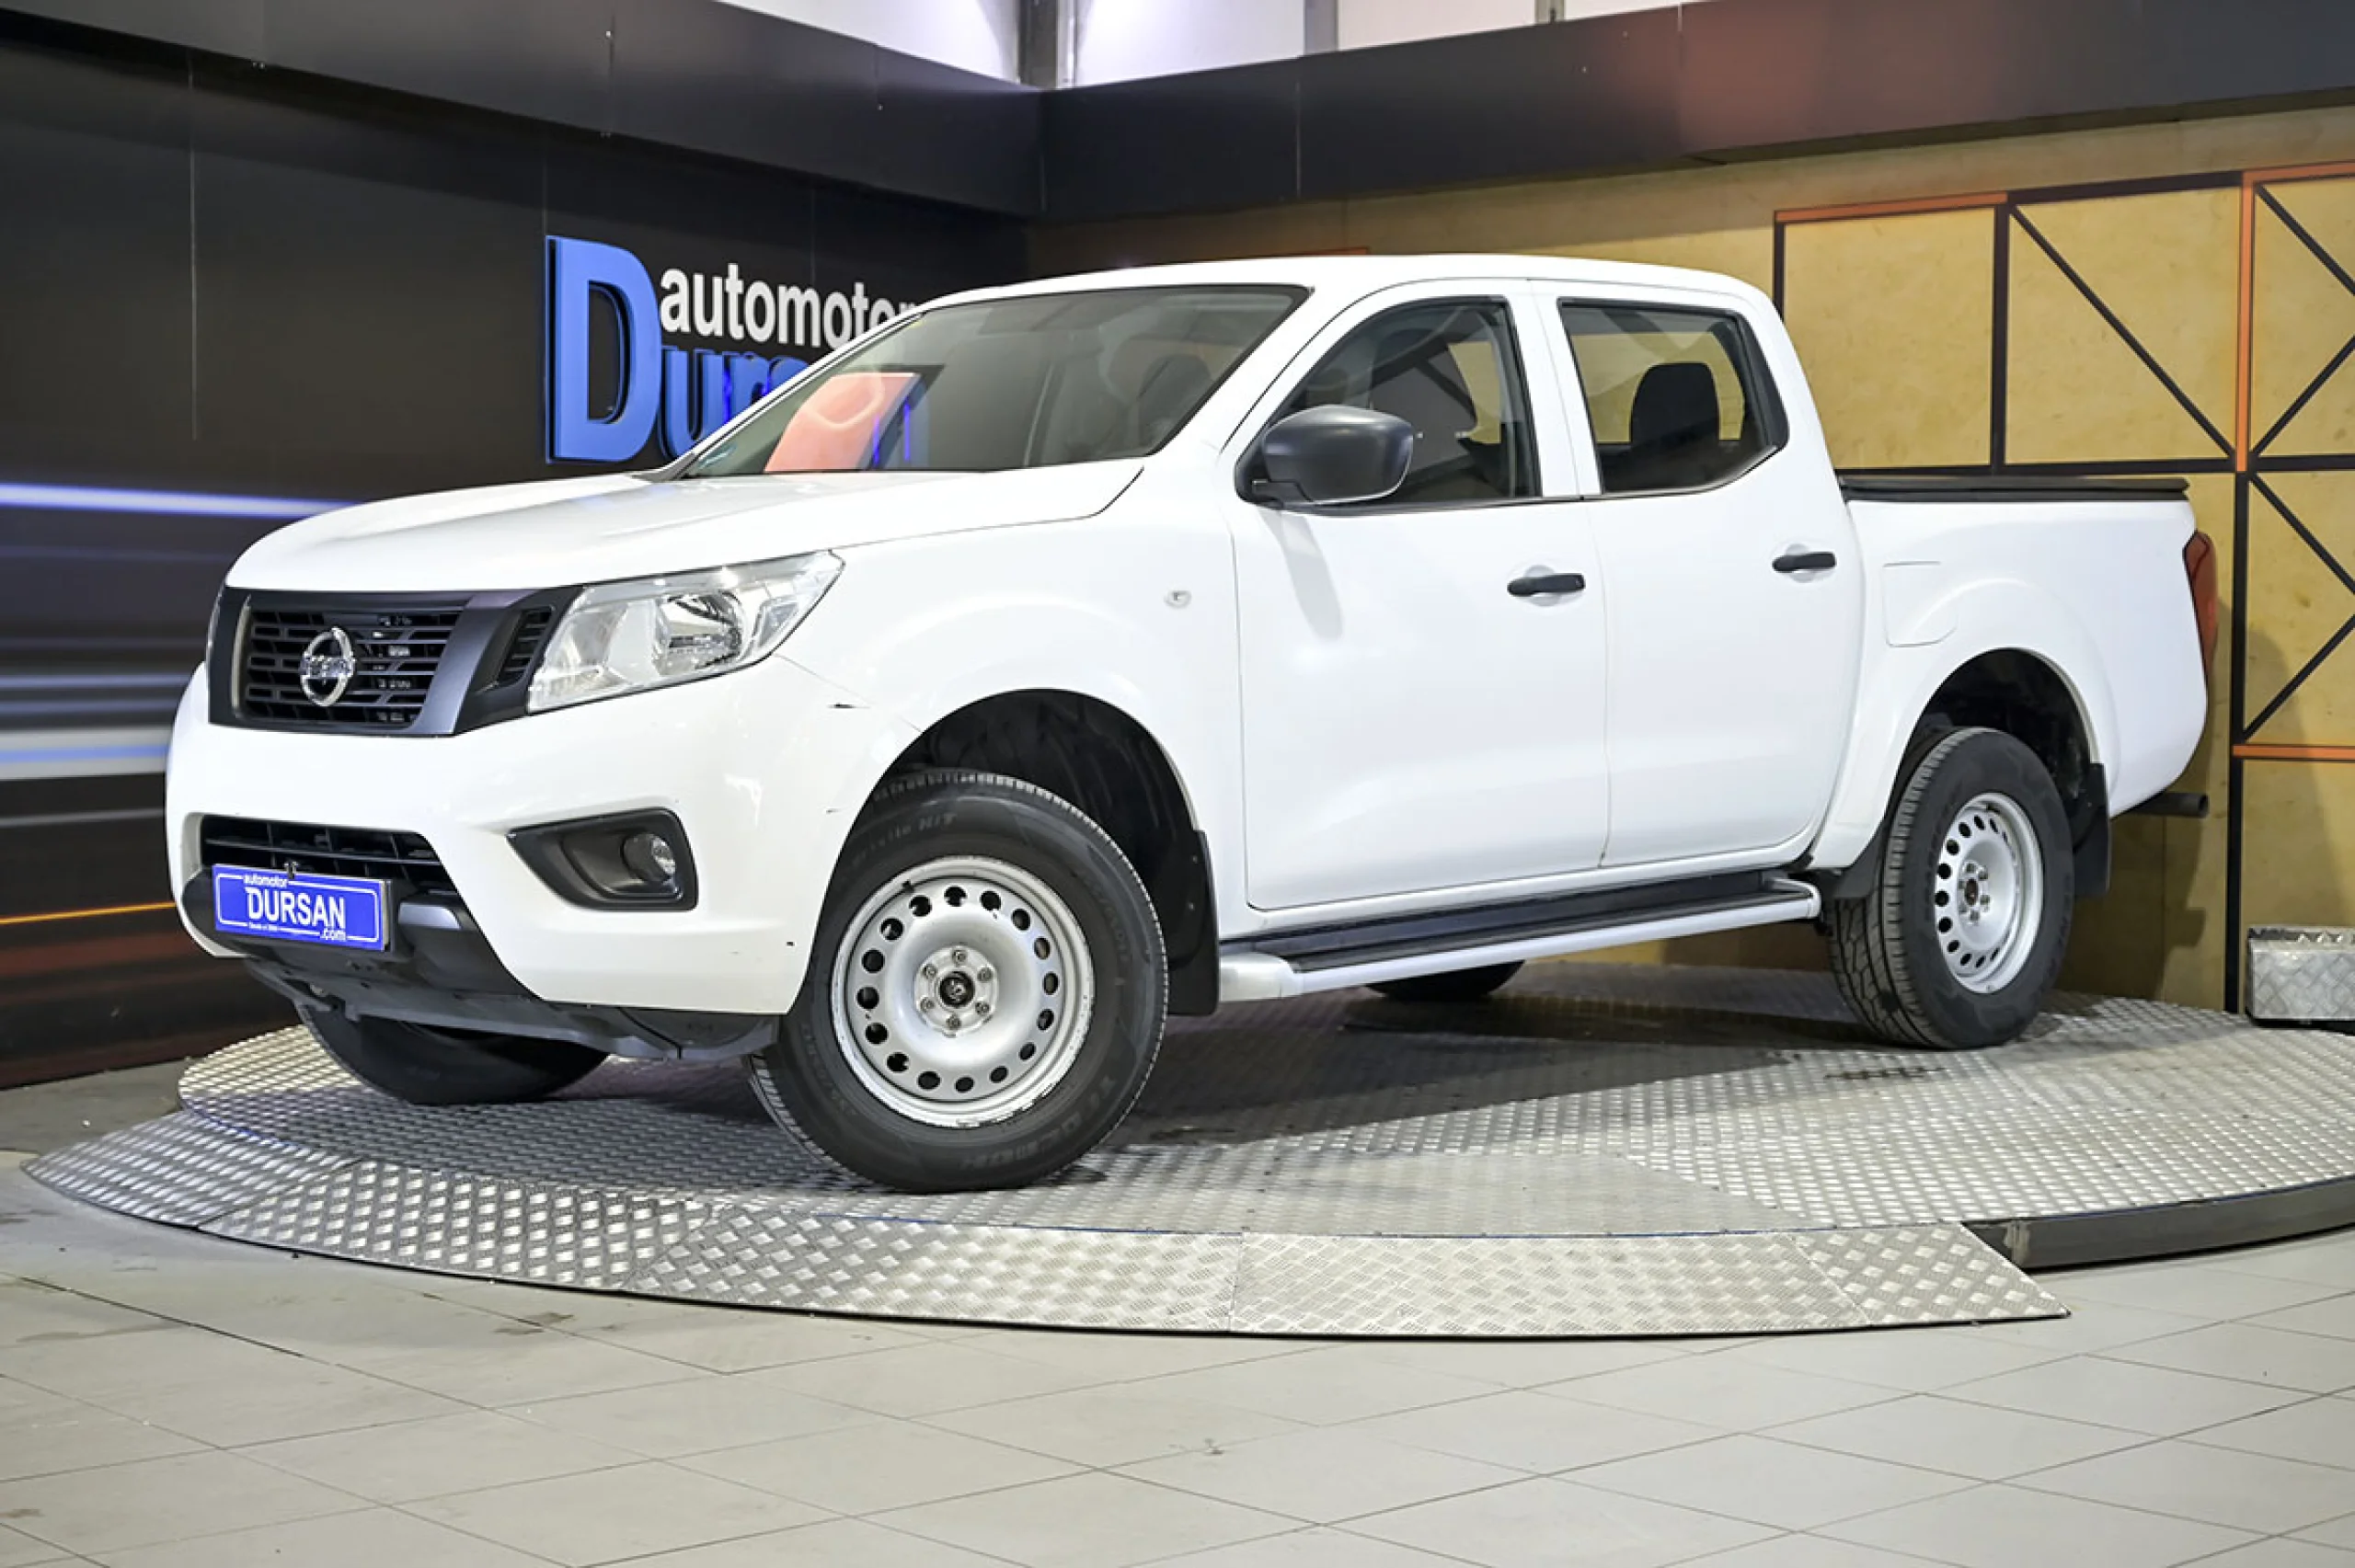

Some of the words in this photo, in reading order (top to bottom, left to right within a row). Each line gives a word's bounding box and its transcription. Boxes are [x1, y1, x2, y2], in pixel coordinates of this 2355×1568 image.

[546, 235, 810, 463] Dur
[661, 263, 917, 349] automot
[245, 887, 346, 929] DURSAN
